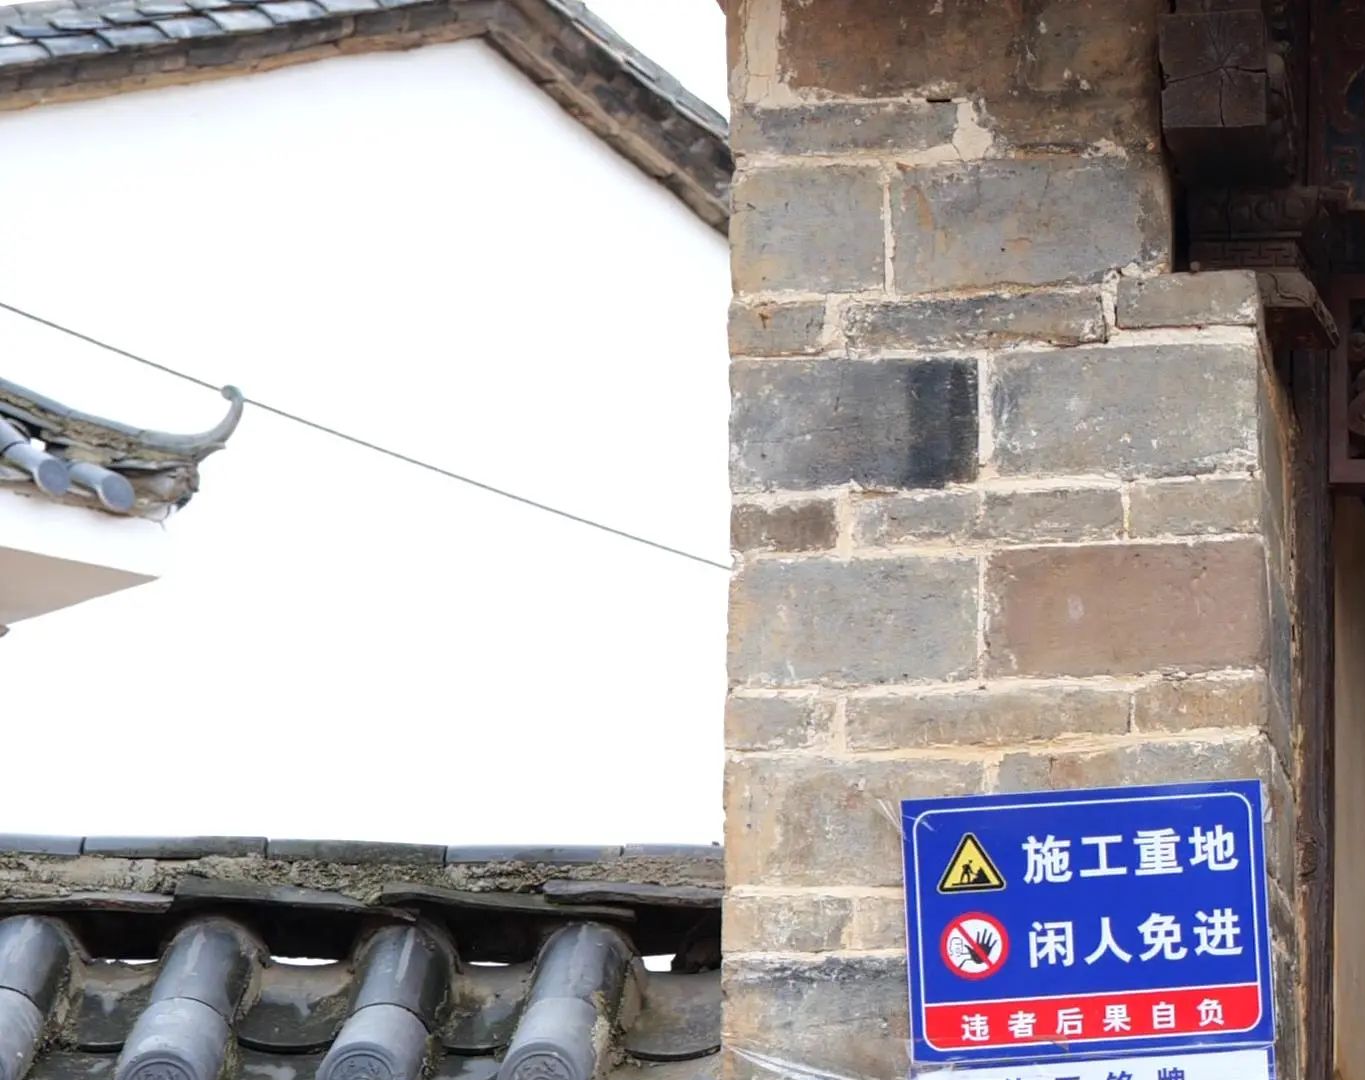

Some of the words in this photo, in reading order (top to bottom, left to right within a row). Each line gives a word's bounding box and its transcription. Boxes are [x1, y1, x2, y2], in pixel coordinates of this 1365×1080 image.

[1023, 825, 1239, 884] 施工重地
[1029, 908, 1243, 969] 闲人免进
[961, 998, 1225, 1042] 违者后果自负
